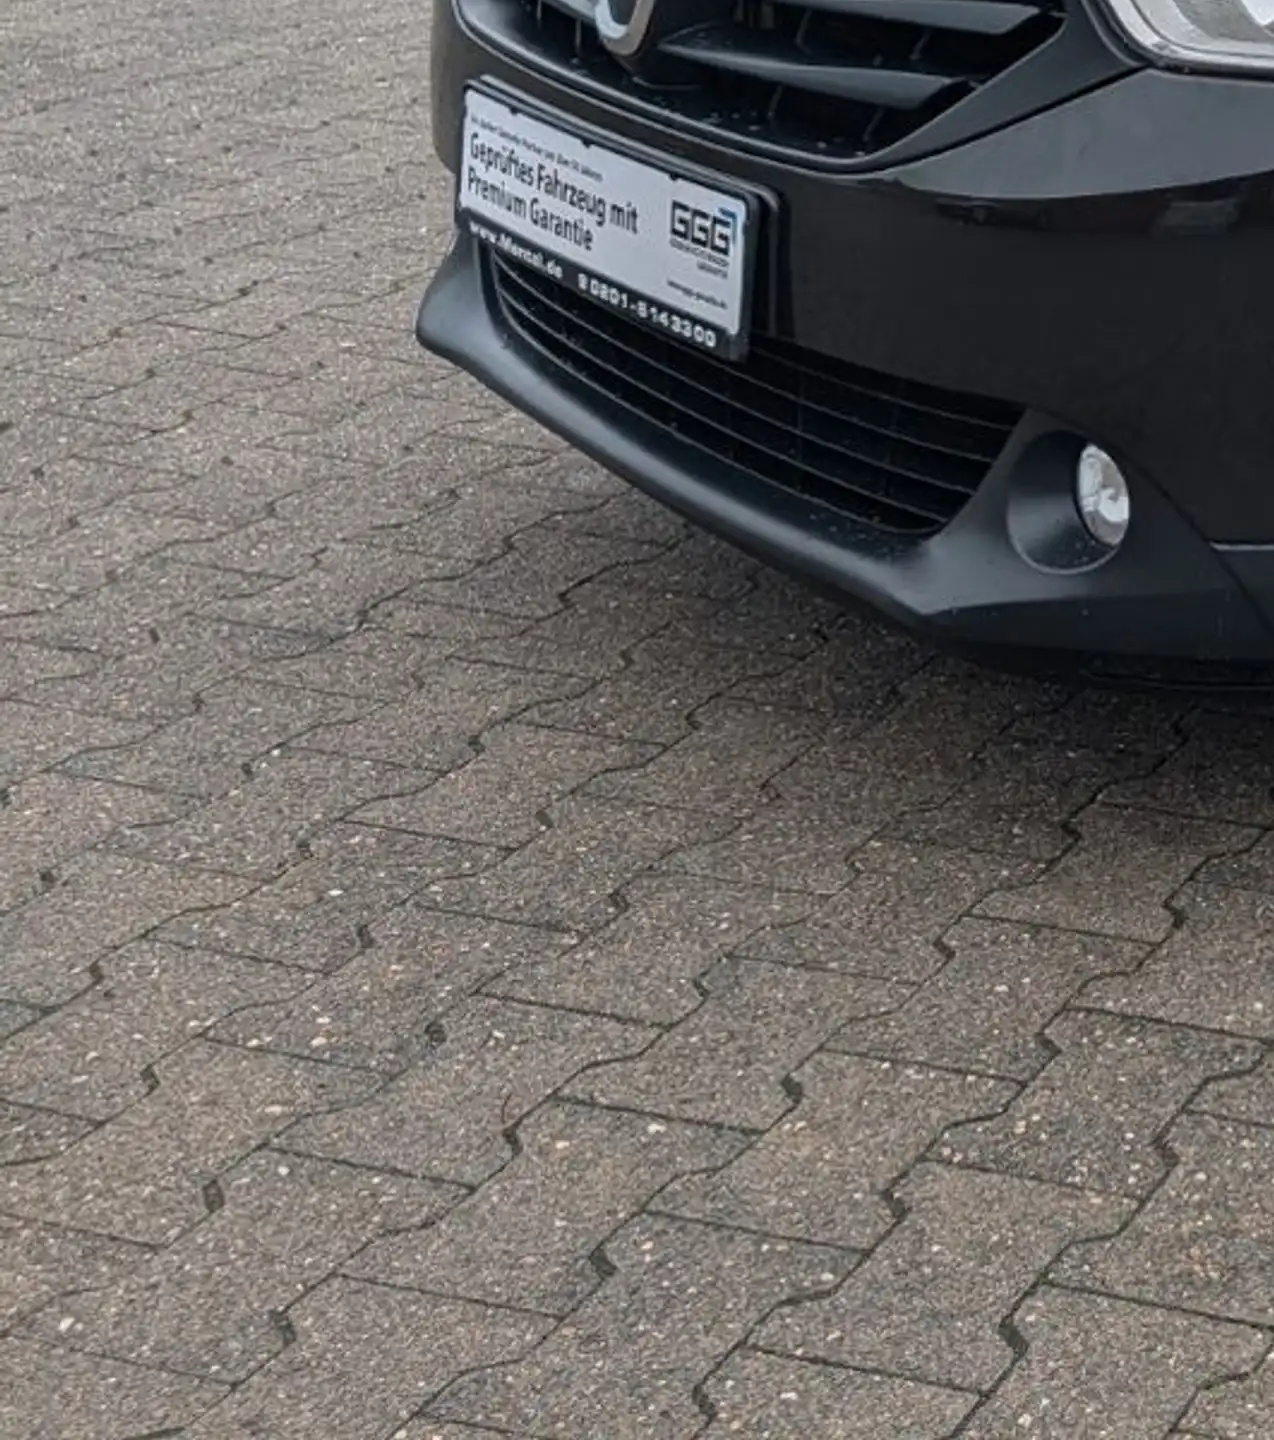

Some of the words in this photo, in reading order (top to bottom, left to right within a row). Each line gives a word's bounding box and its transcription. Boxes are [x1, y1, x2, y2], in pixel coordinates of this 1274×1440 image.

[468, 164, 527, 219] Premium
[530, 196, 594, 251] Garantie
[470, 132, 535, 187] Geprüftes
[536, 163, 607, 227] Fahrzeug
[609, 201, 638, 235] mit
[670, 199, 735, 257] GGG
